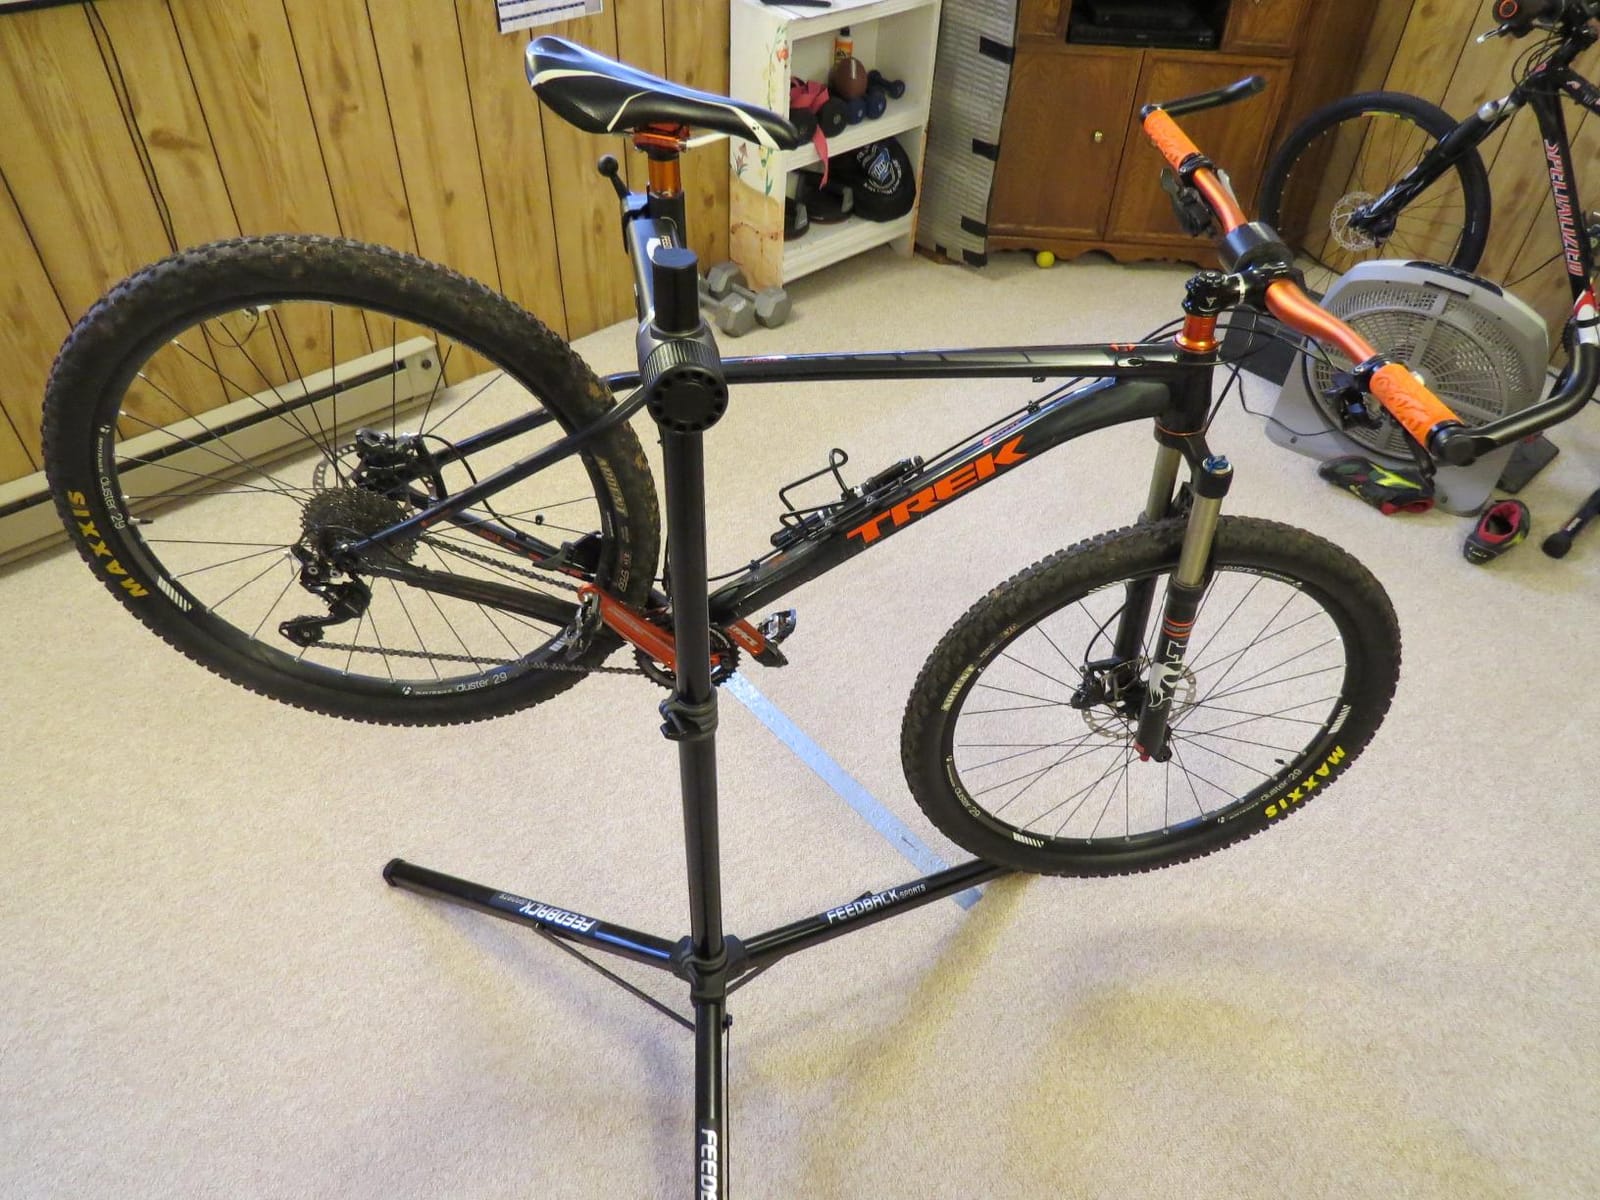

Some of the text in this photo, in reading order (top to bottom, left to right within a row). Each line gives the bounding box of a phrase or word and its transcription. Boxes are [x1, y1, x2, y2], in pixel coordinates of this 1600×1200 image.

[1544, 139, 1584, 277] SPECIALIZED
[846, 434, 1029, 544] TREK
[111, 512, 126, 530] 29
[67, 490, 149, 598] MAXXIS
[456, 679, 489, 692] duster
[492, 671, 508, 685] 29
[1264, 745, 1346, 818] MAXXIS
[1287, 768, 1302, 781] 29
[520, 901, 596, 932] FEEDBACK
[826, 883, 926, 924] FEEDBACK SPORTS
